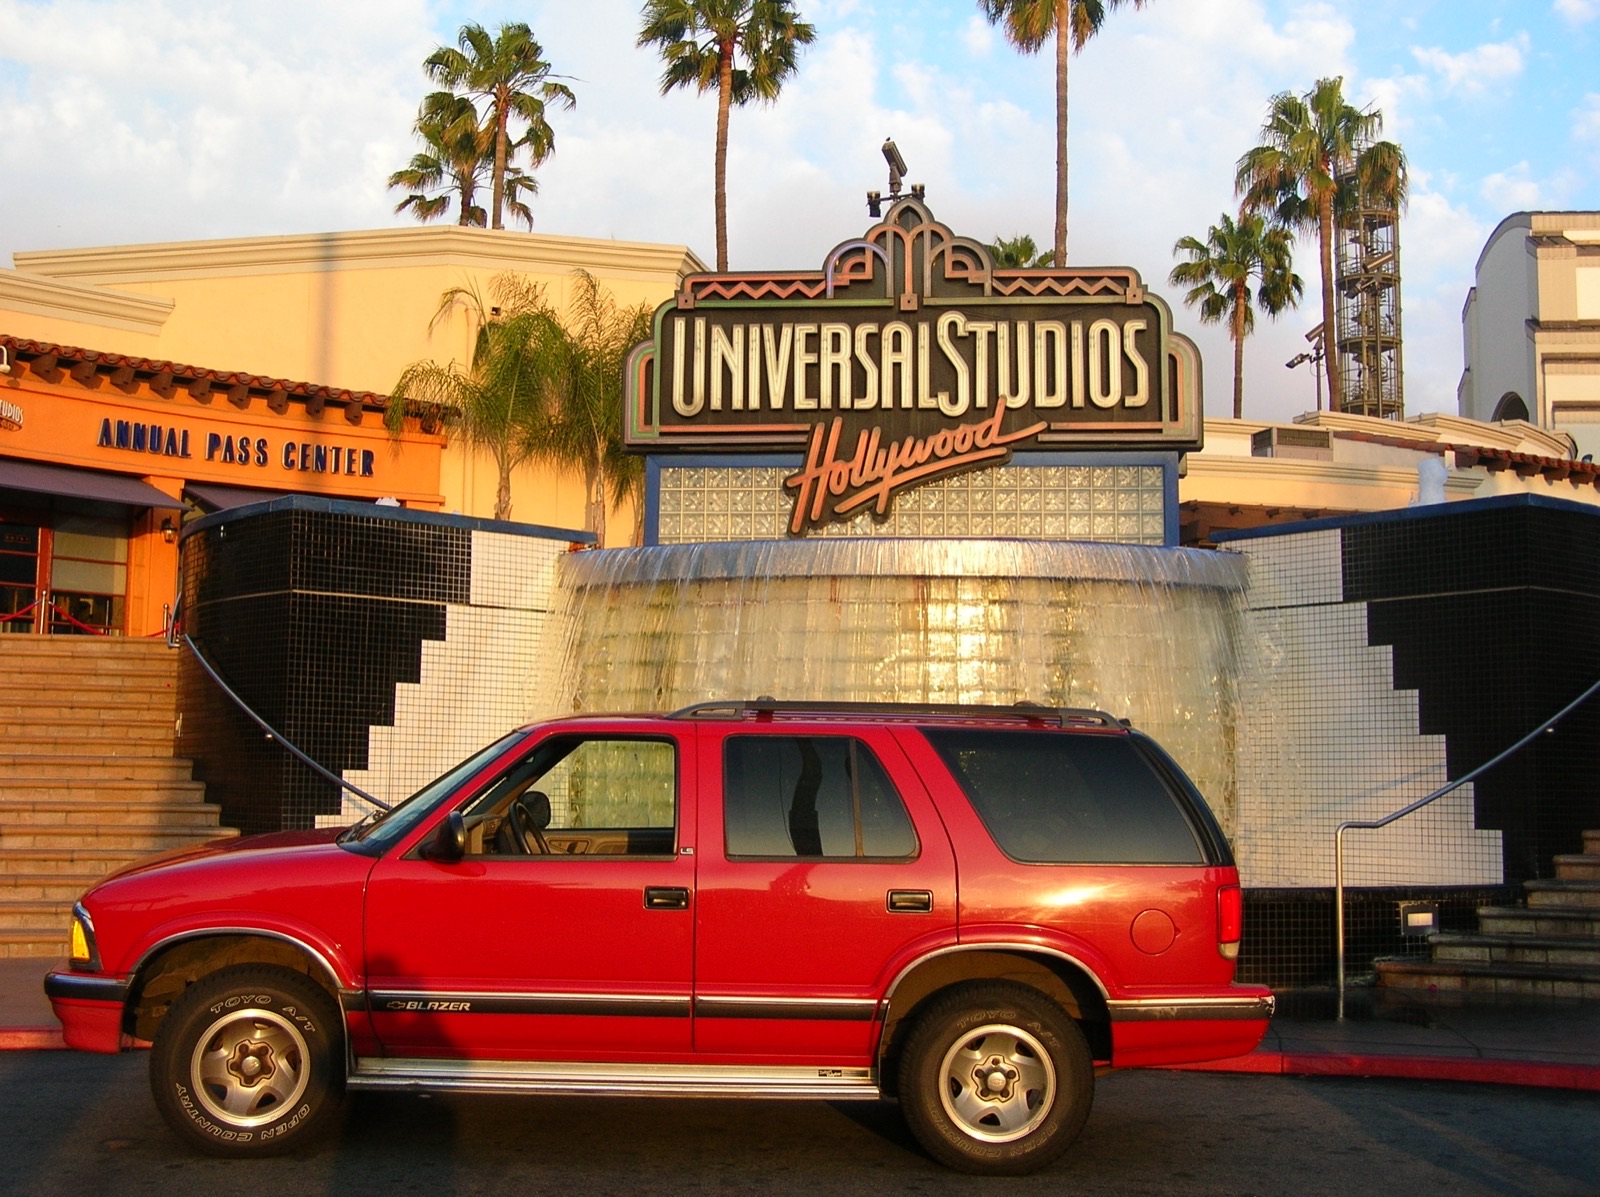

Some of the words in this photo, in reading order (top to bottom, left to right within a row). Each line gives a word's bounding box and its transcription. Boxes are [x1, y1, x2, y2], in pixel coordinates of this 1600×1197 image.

[97, 418, 192, 458] ANNUAL
[205, 432, 268, 466] PASS
[282, 441, 374, 477] CENTER
[785, 394, 1048, 535] Hollywood
[210, 994, 272, 1015] TOYO
[283, 1006, 316, 1033] A/T
[406, 1001, 471, 1011] BLAZER
[956, 1009, 1017, 1029] TOYO
[175, 1082, 253, 1143] COUNTRY
[260, 1104, 311, 1141] OPEN
